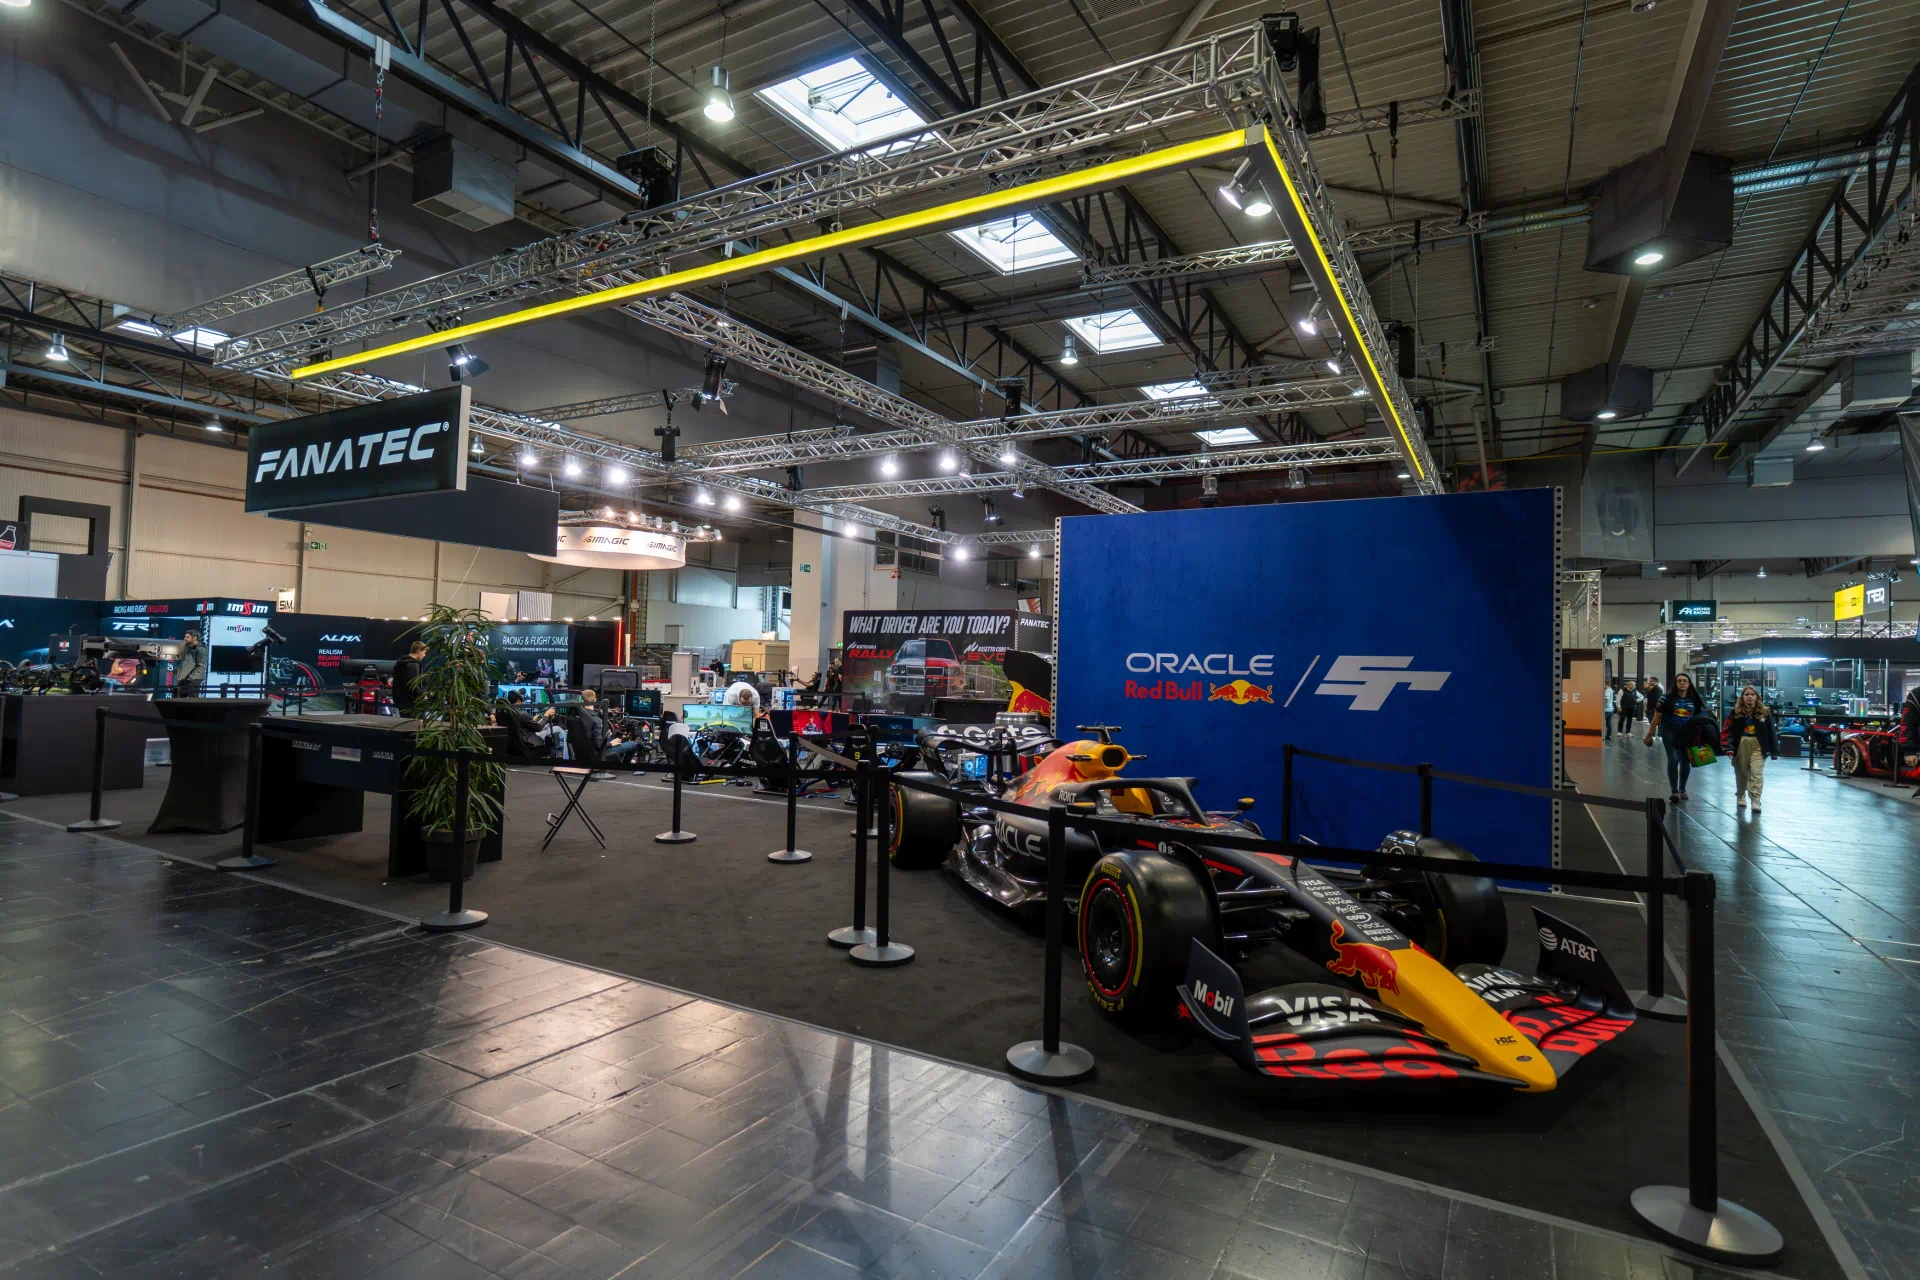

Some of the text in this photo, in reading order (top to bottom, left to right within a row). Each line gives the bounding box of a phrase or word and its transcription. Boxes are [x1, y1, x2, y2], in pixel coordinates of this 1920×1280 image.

[586, 535, 630, 545] SIMAGIC
[647, 541, 678, 552] SIMAGIC
[850, 616, 1010, 635] WHAT DRIVER ARE YOU TODAY?
[502, 636, 523, 645] RACING
[530, 636, 551, 645] FLIGHT
[849, 649, 896, 659] RALLY
[1125, 652, 1275, 676] ORACLE
[1125, 679, 1203, 701] Red Bull
[854, 752, 861, 760] 9
[1560, 937, 1598, 962] AT&T
[1194, 979, 1235, 1018] Mobil
[1275, 996, 1381, 1026] VISA
[1252, 1029, 1459, 1081] Red
